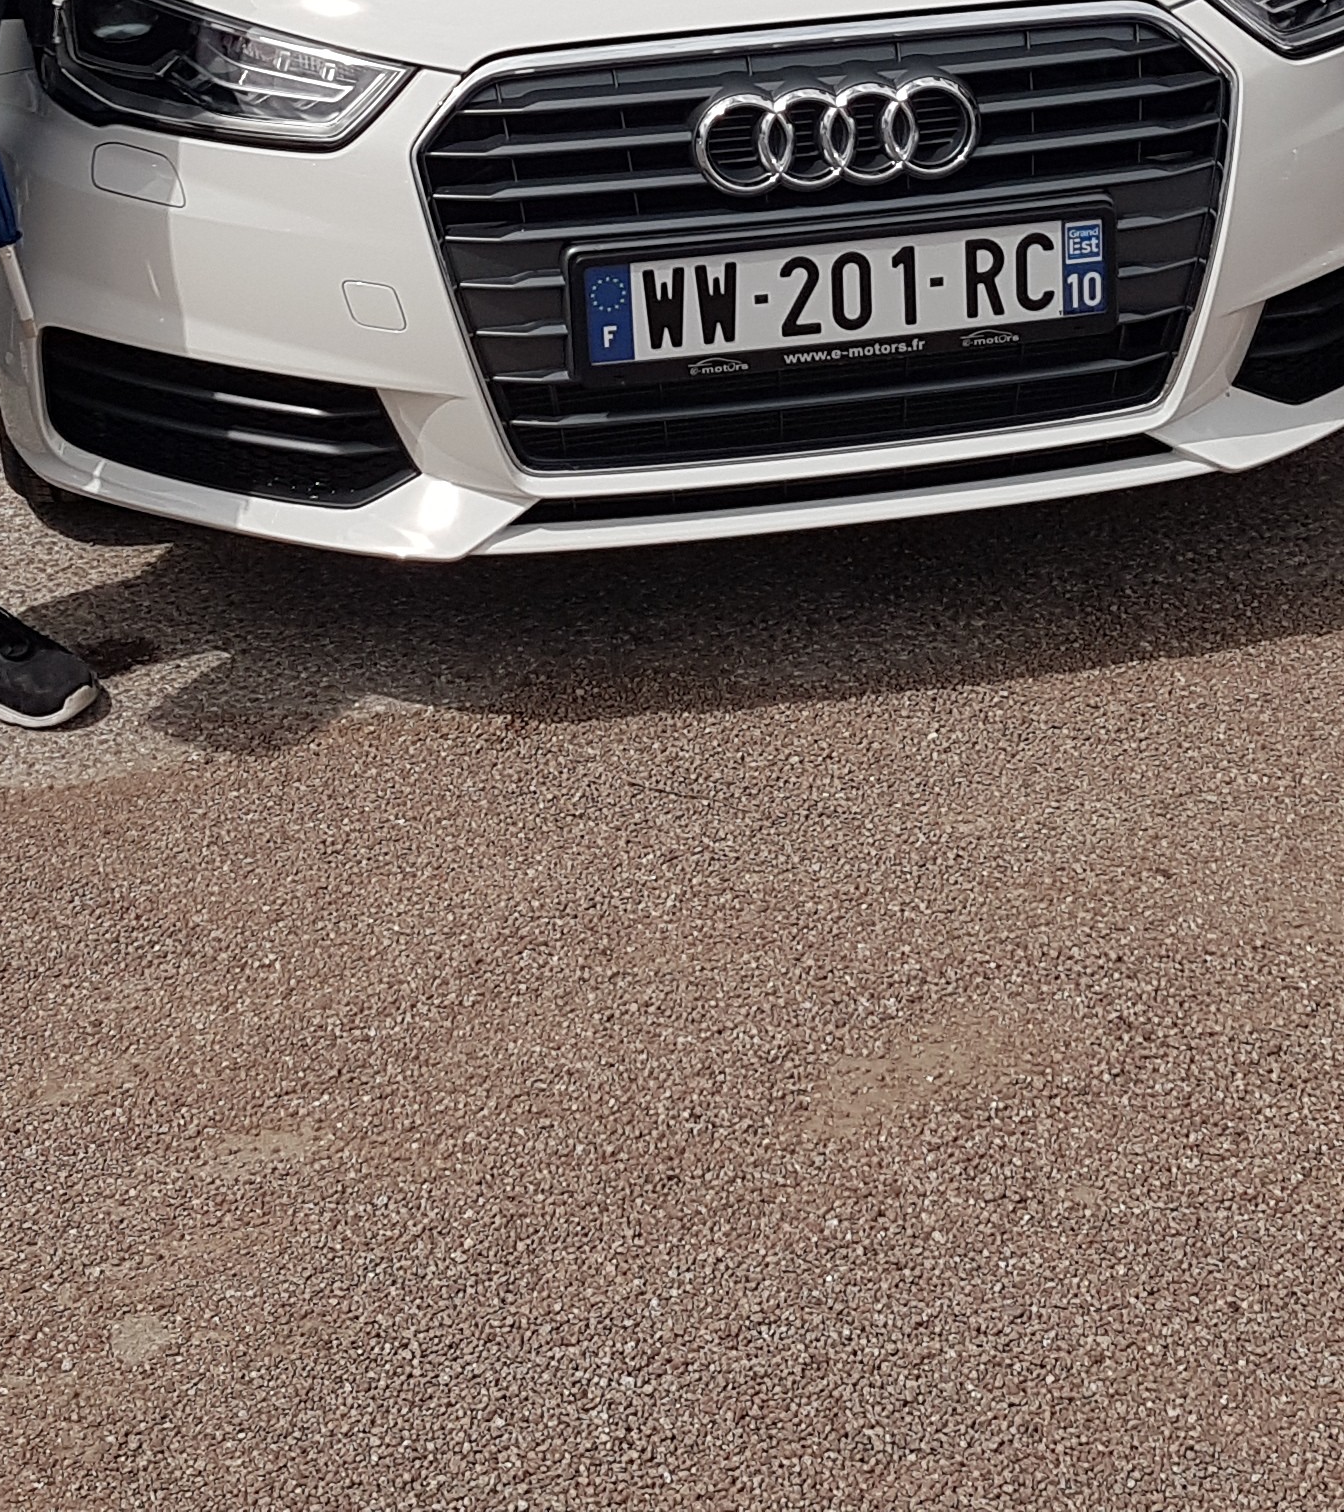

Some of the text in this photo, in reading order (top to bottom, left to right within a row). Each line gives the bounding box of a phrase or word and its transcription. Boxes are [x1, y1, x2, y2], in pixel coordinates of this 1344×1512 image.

[1069, 227, 1099, 238] Grand
[1069, 236, 1099, 255] Est
[1067, 271, 1102, 309] 10
[603, 325, 617, 348] F
[783, 338, 925, 364] www.e-motors.fr
